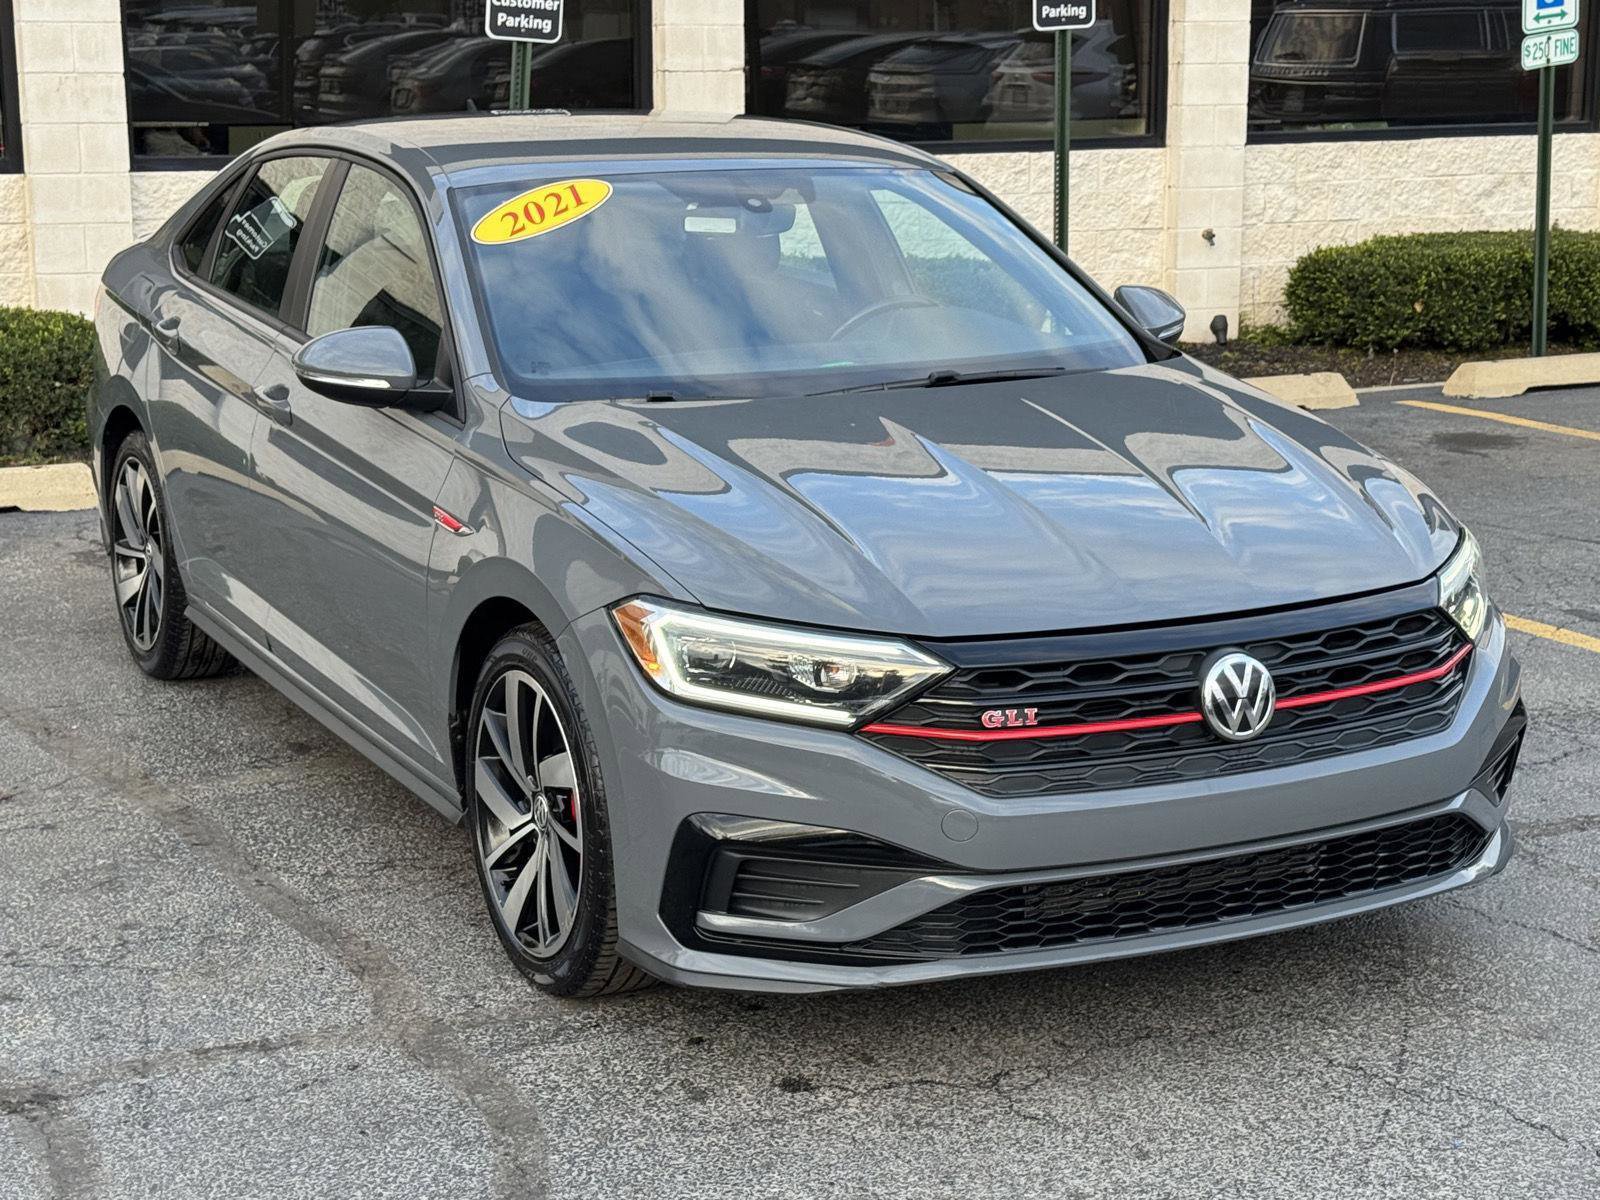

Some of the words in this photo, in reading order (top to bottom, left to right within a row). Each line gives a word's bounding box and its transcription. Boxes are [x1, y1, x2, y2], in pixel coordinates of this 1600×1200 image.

[1042, 4, 1087, 19] Parking
[497, 12, 552, 34] Parking
[1524, 41, 1550, 61] $250
[1554, 37, 1576, 57] FINE
[500, 184, 588, 237] 2021
[981, 708, 1038, 728] GLI
